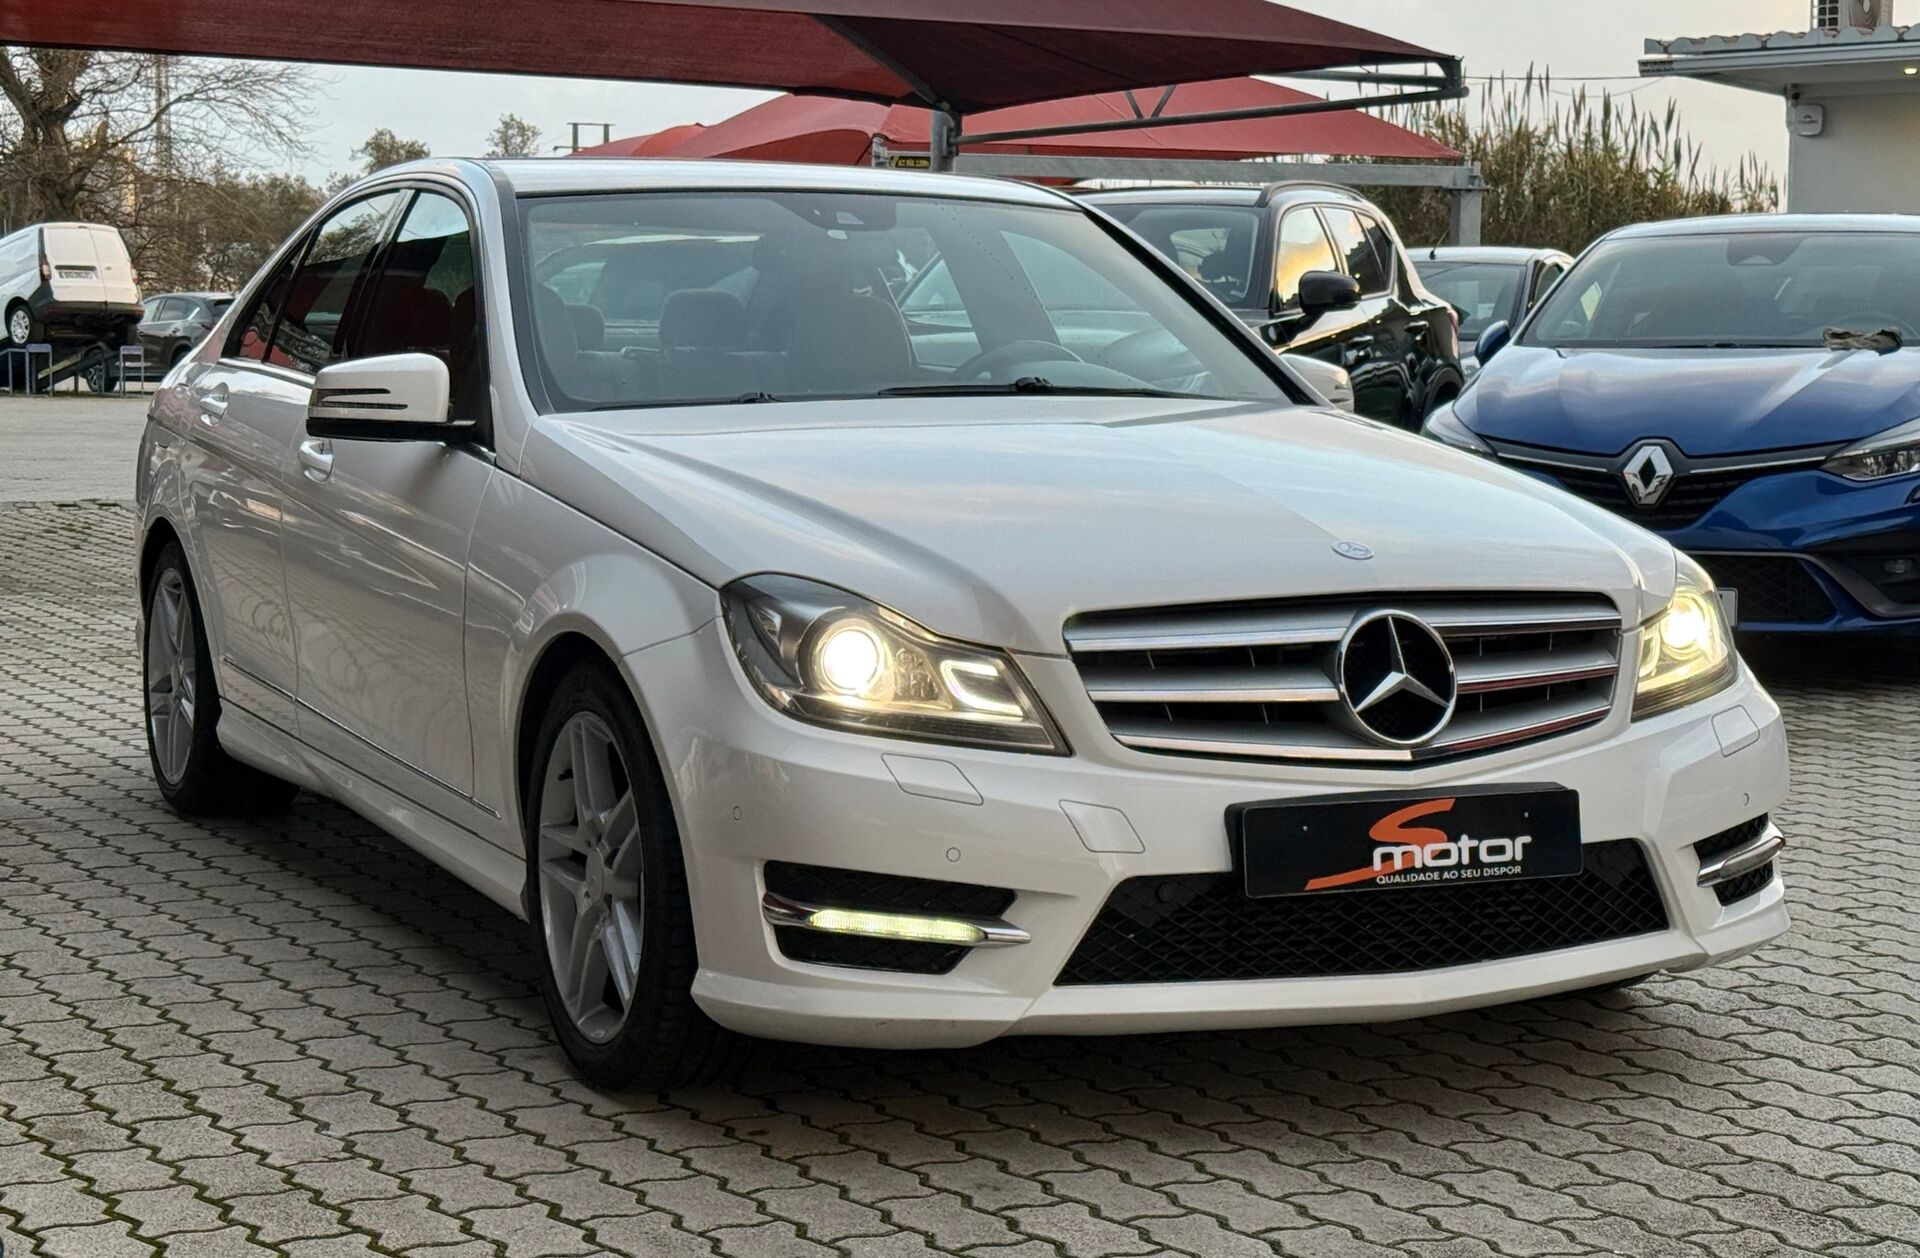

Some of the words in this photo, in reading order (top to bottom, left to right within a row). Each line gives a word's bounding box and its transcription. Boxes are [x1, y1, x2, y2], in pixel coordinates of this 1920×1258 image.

[1376, 871, 1441, 885] QUALIDADE
[1442, 870, 1459, 880] AO
[1460, 868, 1481, 879] SEU
[1483, 865, 1522, 877] DISPOR
